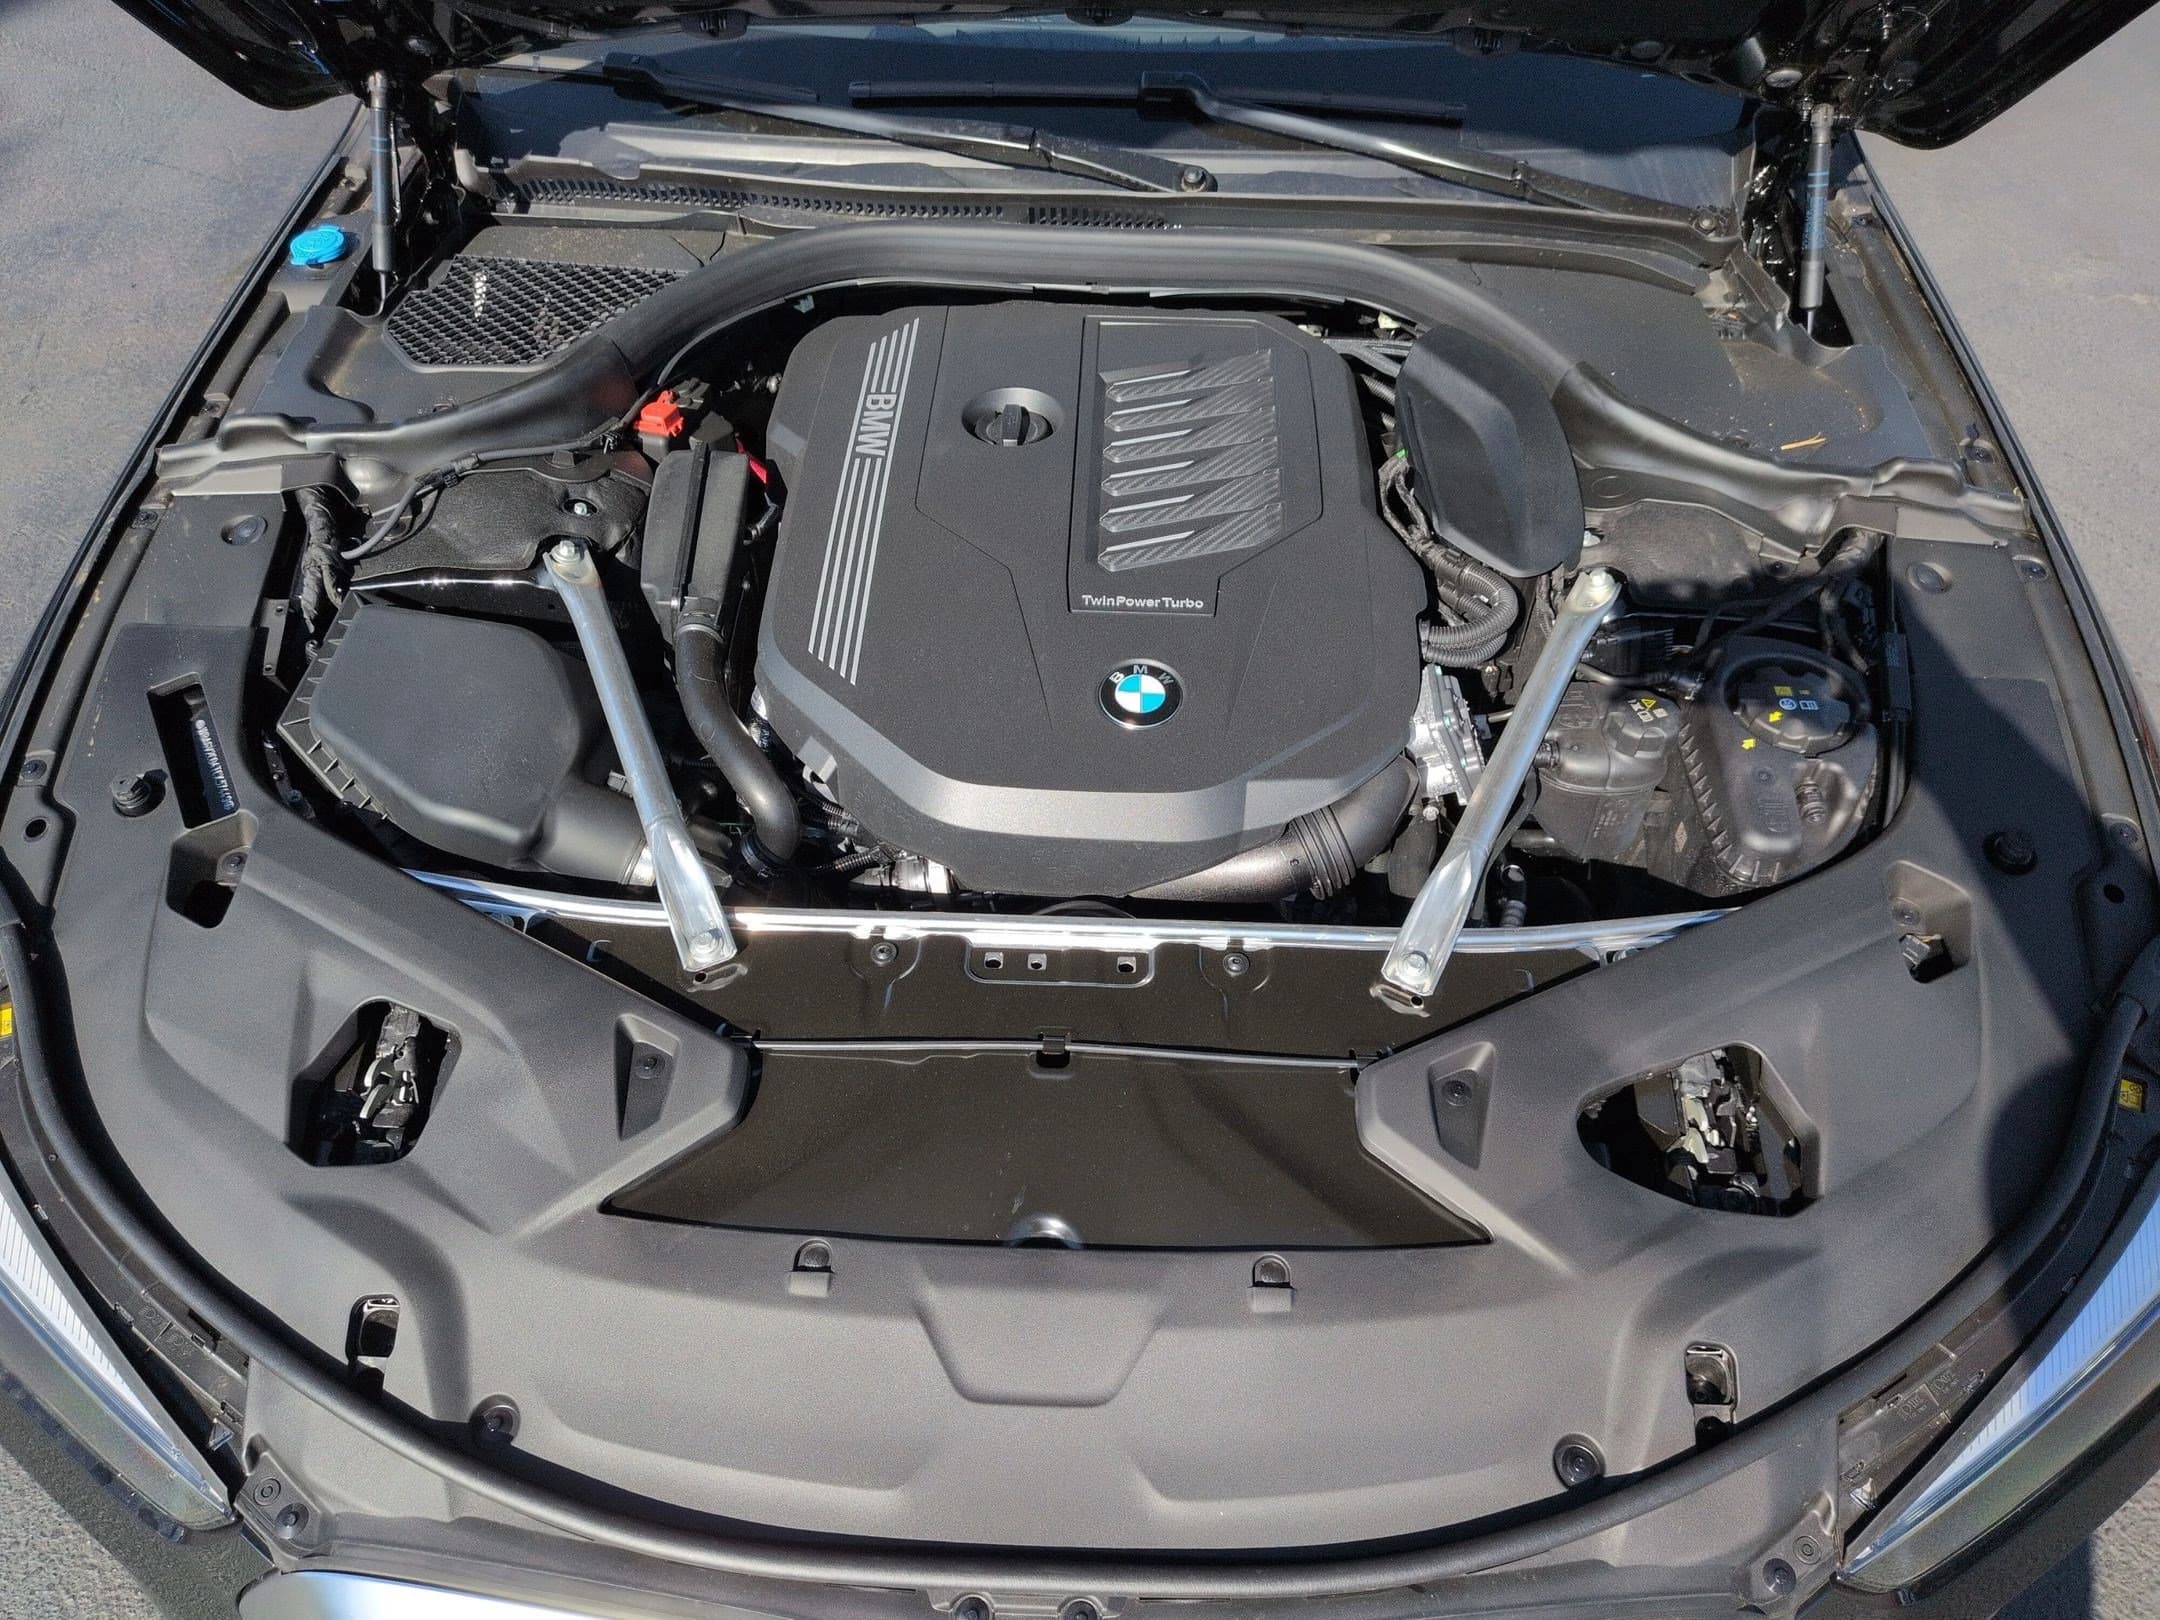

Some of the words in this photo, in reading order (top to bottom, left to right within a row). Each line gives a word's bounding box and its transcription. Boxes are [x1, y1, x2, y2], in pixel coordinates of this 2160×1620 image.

[855, 394, 897, 456] BMW
[1162, 596, 1204, 609] Turbo
[1109, 664, 1174, 685] BMW
